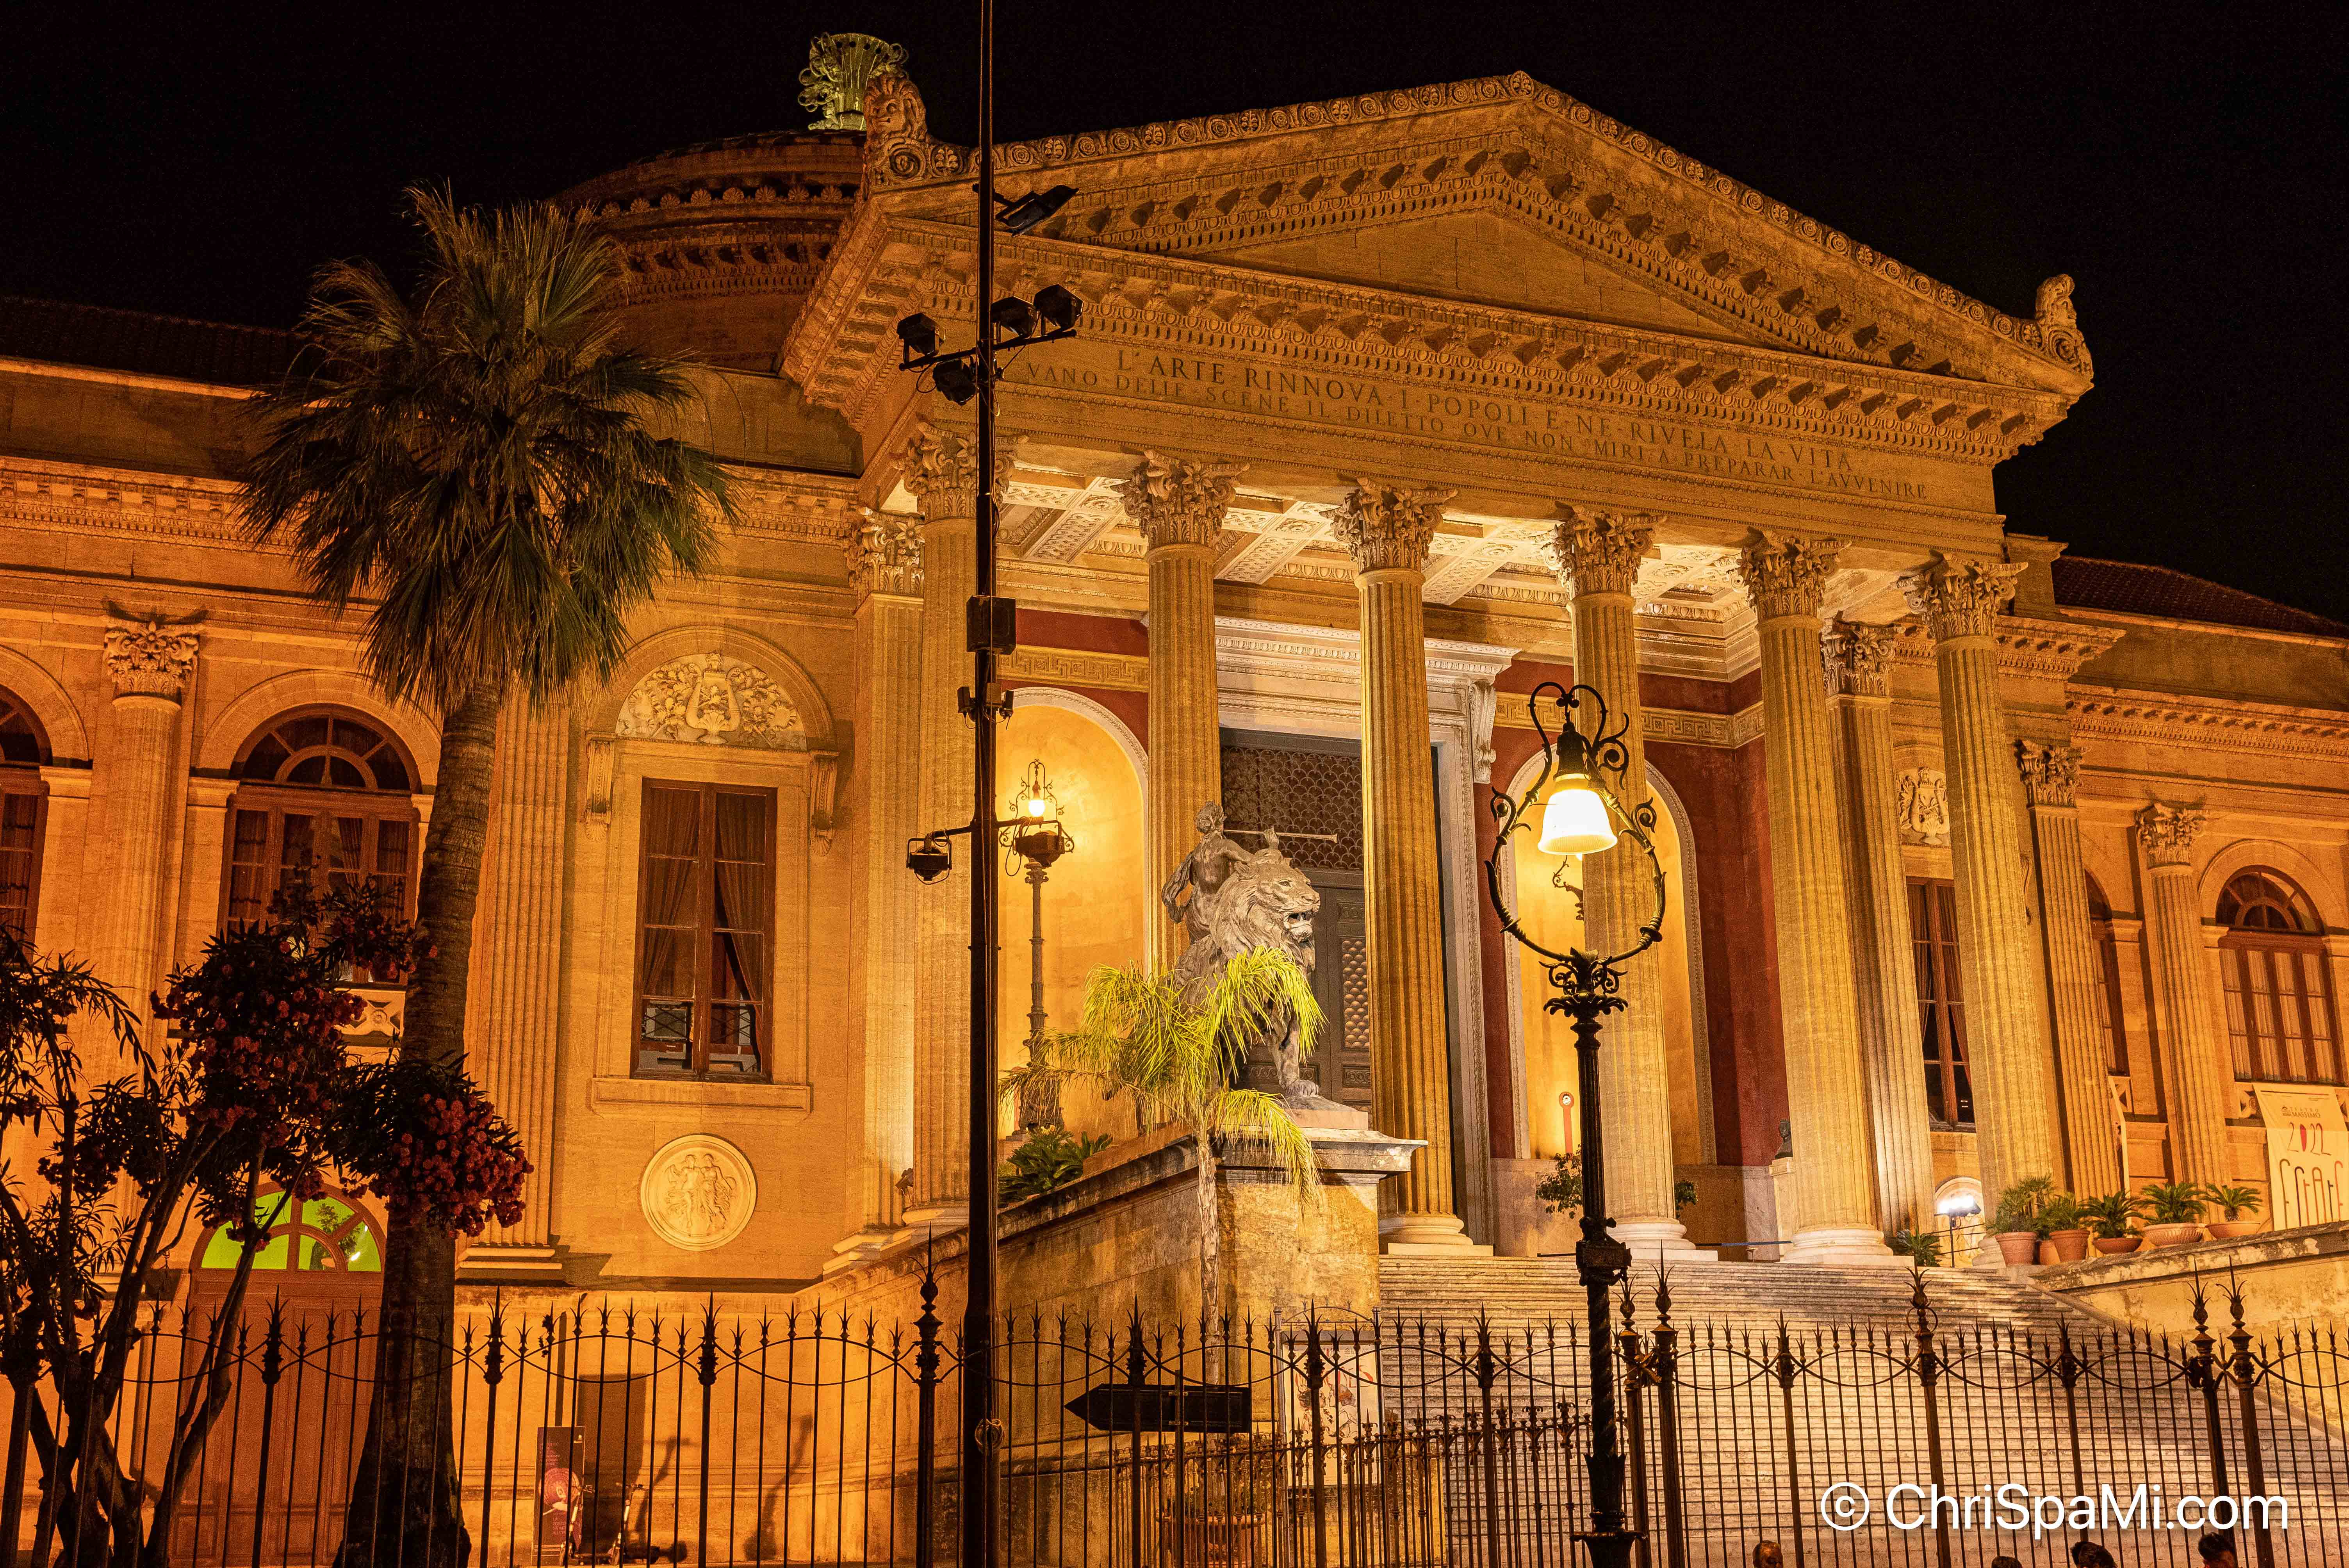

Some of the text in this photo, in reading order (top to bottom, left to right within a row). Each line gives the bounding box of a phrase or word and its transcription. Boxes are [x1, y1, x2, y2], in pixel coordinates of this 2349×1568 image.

[1028, 363, 1098, 387] VANO
[1207, 387, 1289, 412] SCENE
[1525, 431, 1573, 451] NON
[1245, 367, 1382, 406] RINNOVA
[1428, 393, 1527, 425] POPOLI
[1631, 422, 1727, 454] RIVELA
[1747, 438, 1773, 460] LA
[1789, 444, 1852, 470] VITA
